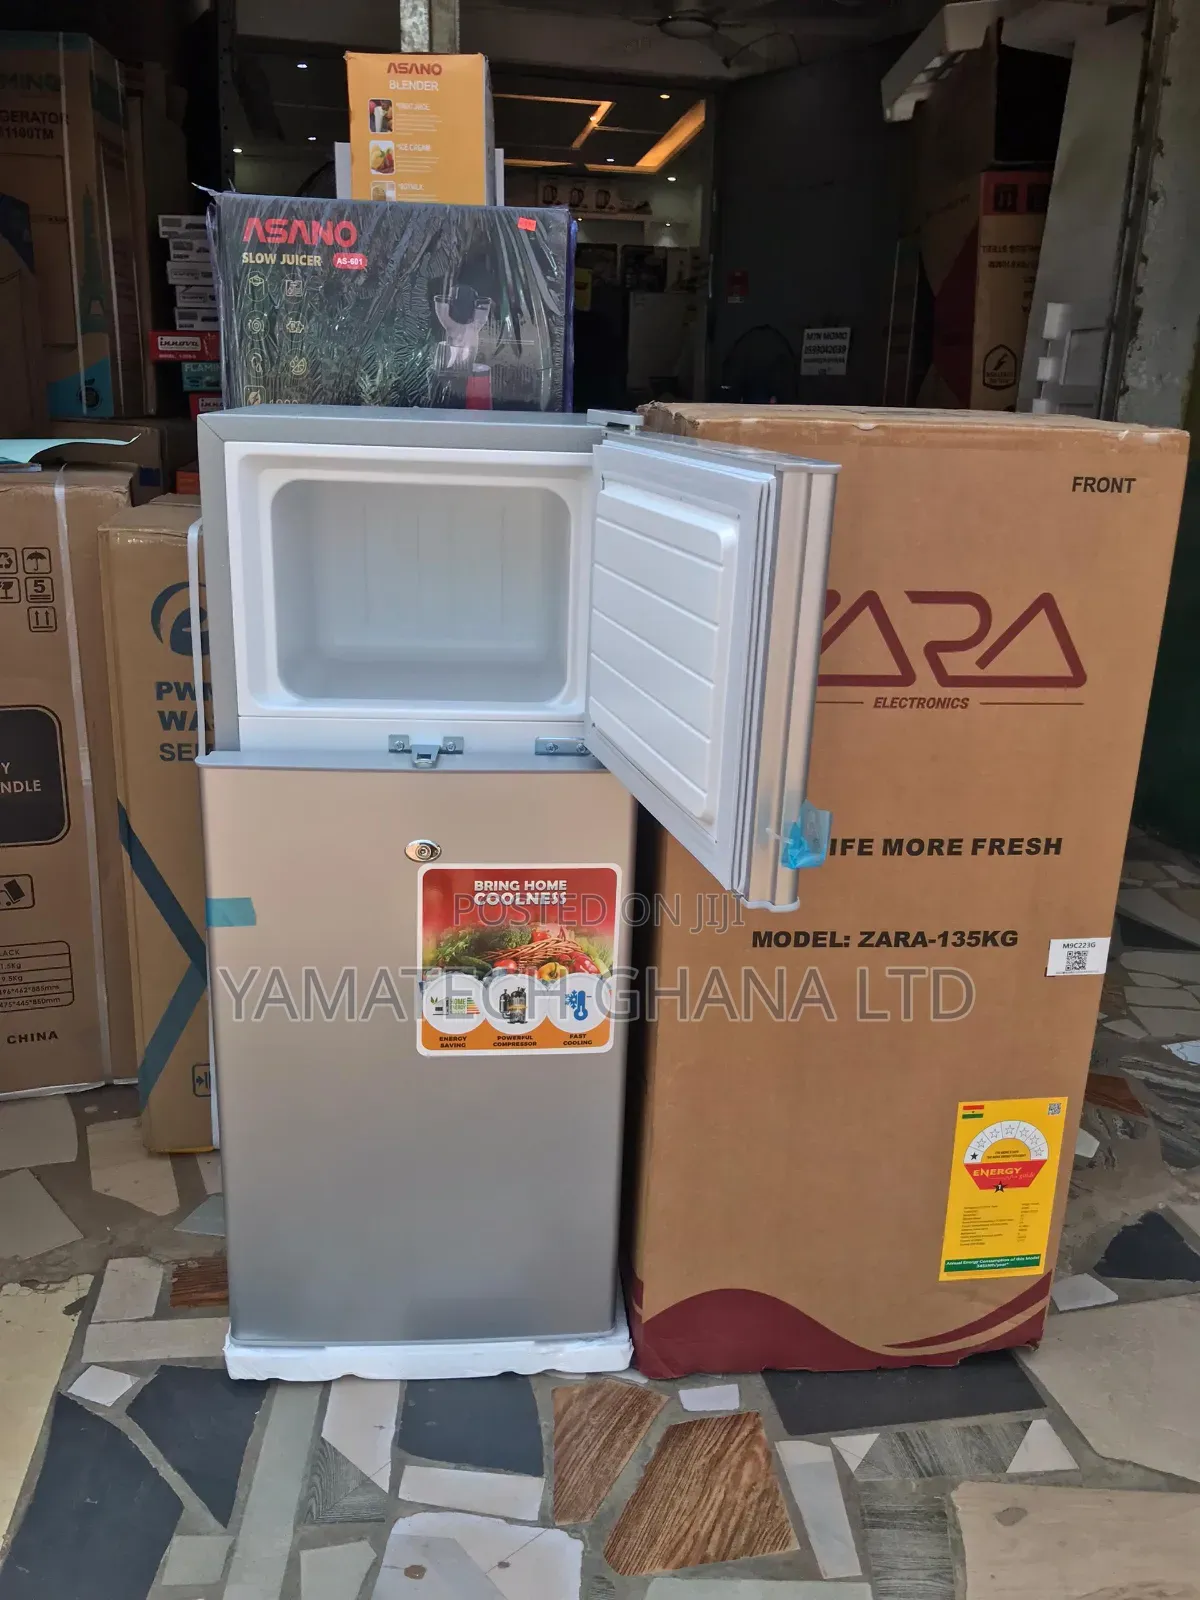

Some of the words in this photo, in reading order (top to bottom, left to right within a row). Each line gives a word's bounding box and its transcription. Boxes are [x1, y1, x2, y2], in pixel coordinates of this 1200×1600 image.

[386, 62, 443, 76] ASANO
[389, 79, 440, 92] BLENDER
[242, 217, 358, 248] ASANO
[242, 252, 277, 265] SLOW
[280, 253, 322, 267] JUICER
[336, 257, 364, 266] AS-601
[1071, 476, 1137, 494] FRONT
[33, 579, 45, 594] 5
[819, 589, 1088, 689] ARA
[873, 697, 970, 710] ELECTRONICS
[830, 838, 874, 857] IFE
[881, 837, 963, 857] MORE
[970, 837, 1063, 856] FRESH
[474, 880, 520, 892] BRING
[524, 880, 567, 892] HOME
[473, 892, 567, 906] COOLNESS
[752, 930, 851, 948] MODEL:
[857, 930, 1019, 949] ZARA-135KG
[1062, 941, 1096, 950] M9C223G
[7, 1030, 59, 1045] CHINA
[492, 1040, 537, 1048] COMPRESSOR
[973, 1166, 1022, 1178] ENERGY
